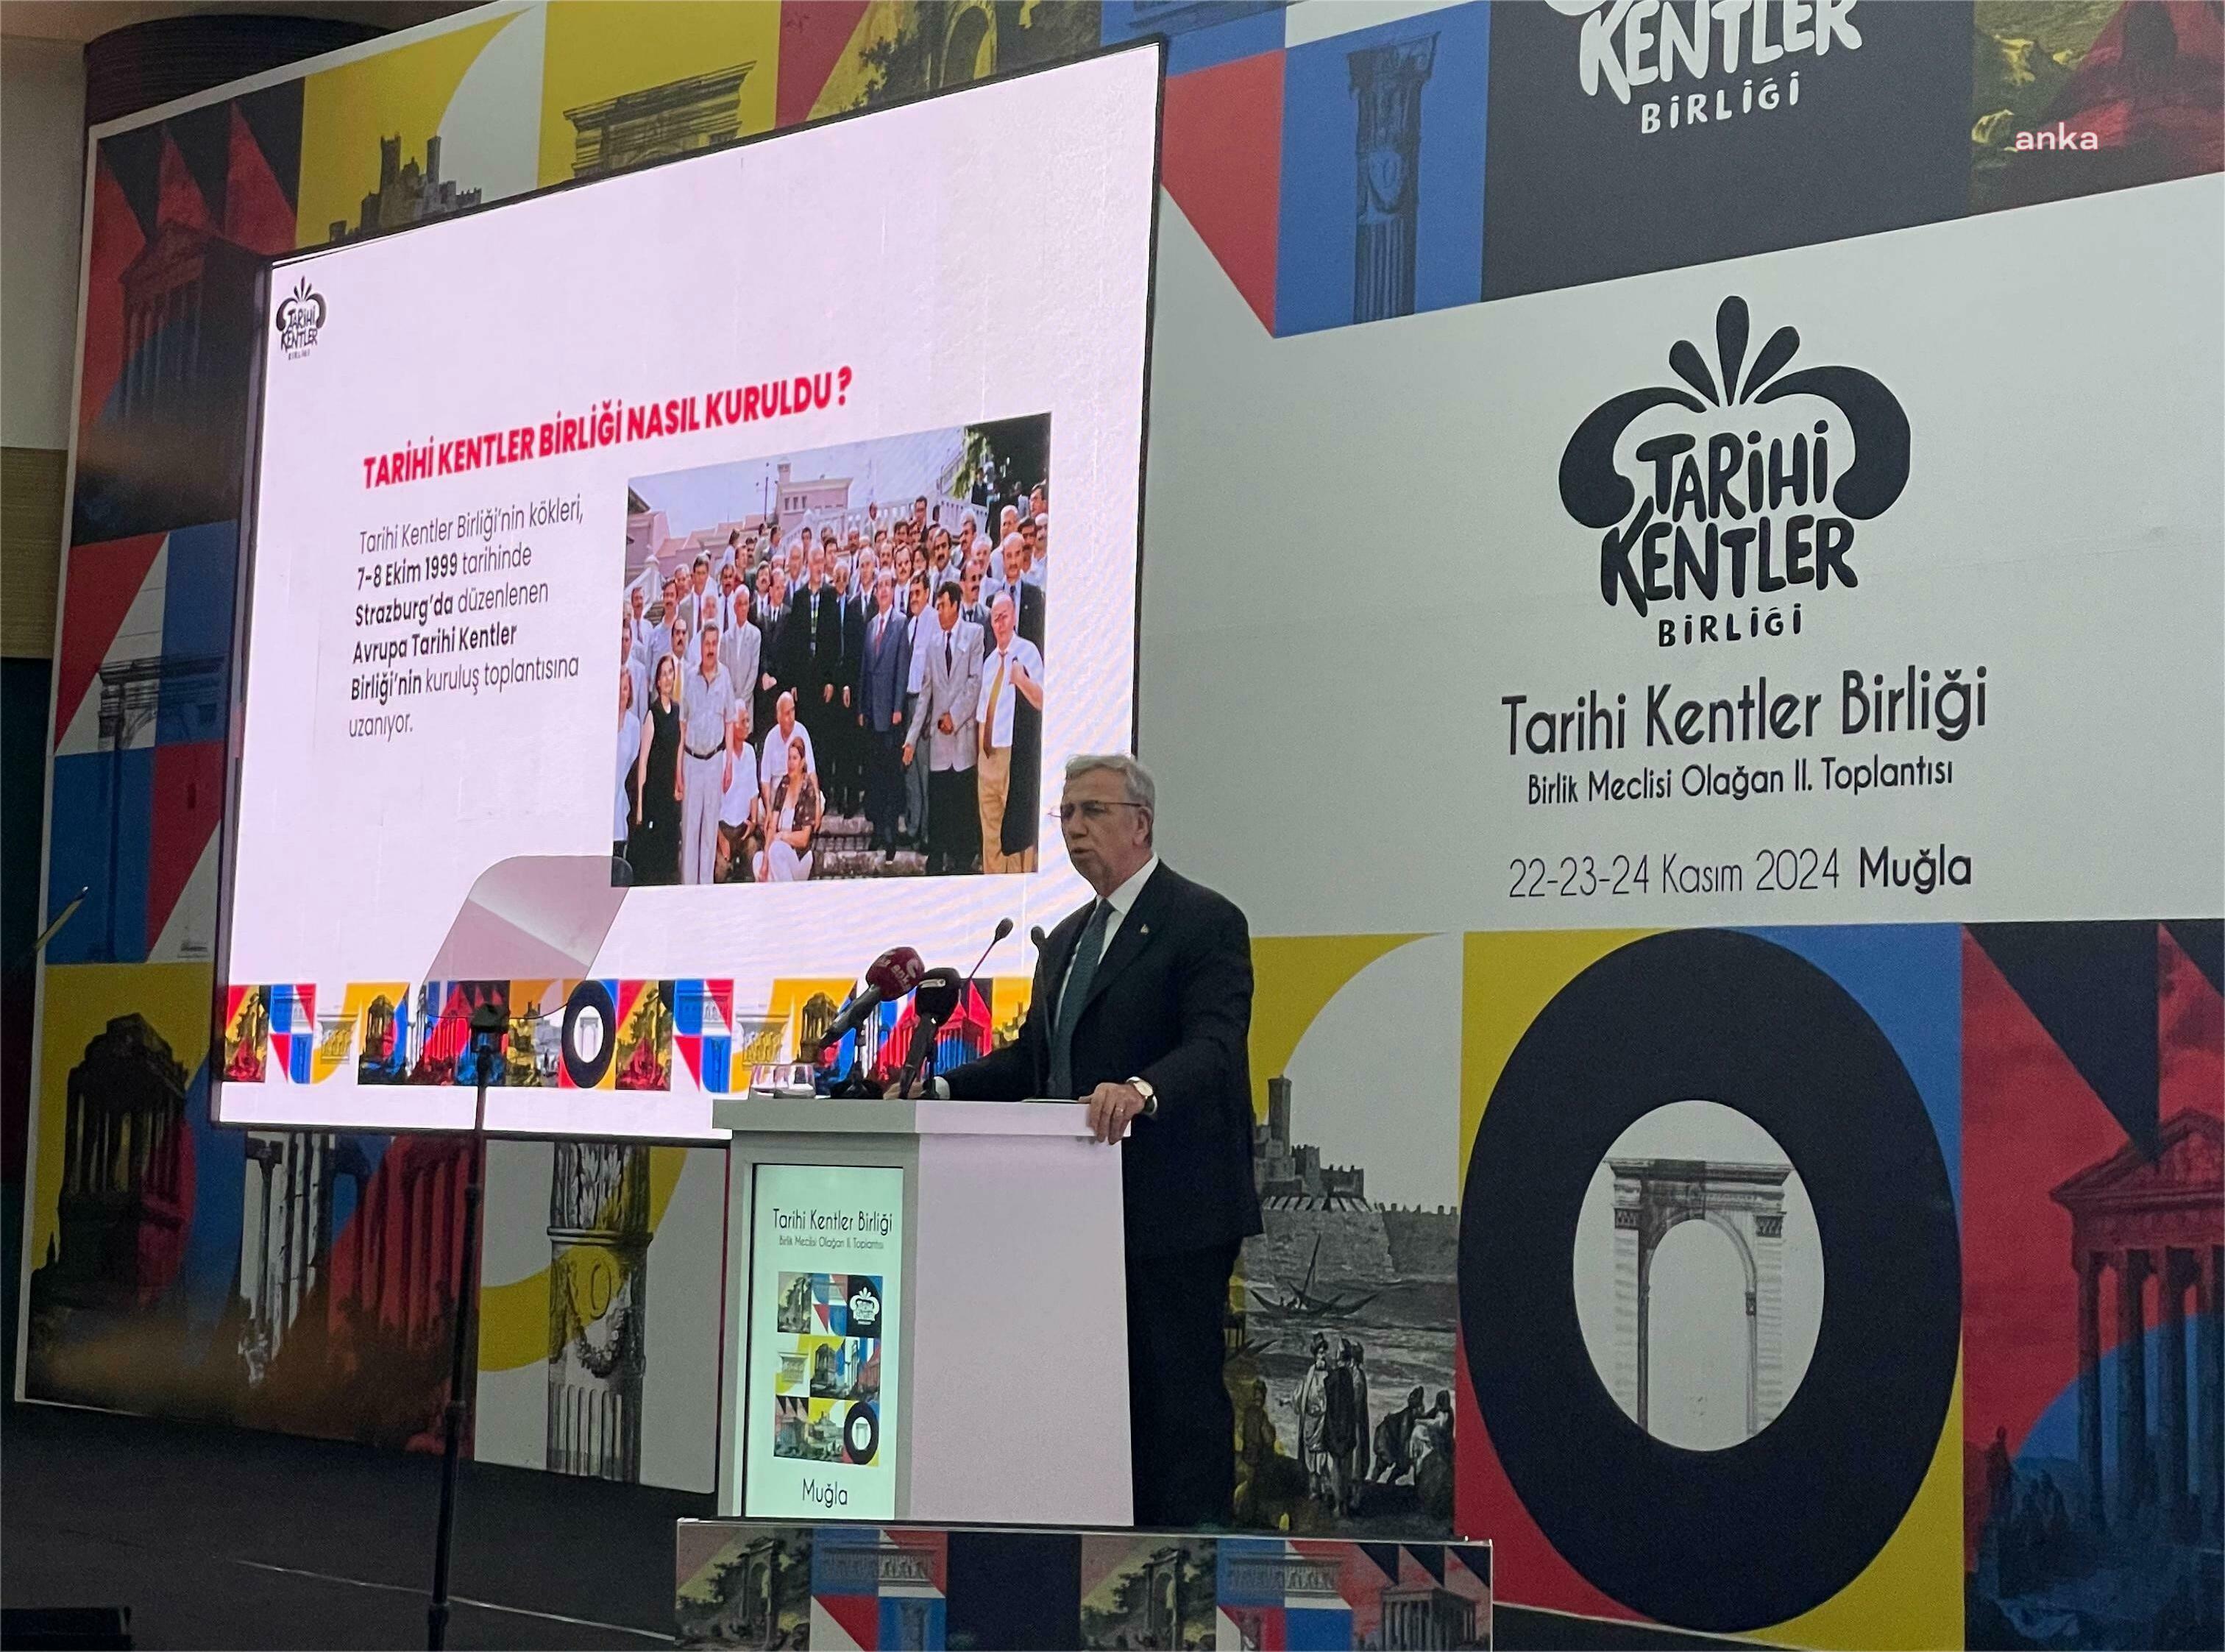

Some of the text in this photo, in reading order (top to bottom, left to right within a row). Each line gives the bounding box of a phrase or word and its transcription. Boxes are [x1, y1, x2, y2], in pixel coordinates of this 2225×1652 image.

[1579, 0, 1863, 104] KENTLER
[280, 325, 318, 352] KENTLER
[363, 435, 434, 489] TARİHİ
[438, 427, 535, 476] KENTLER
[539, 399, 622, 458] BİRLİĞİ
[627, 396, 700, 442] NASIL
[705, 372, 832, 428] KURULDU
[360, 523, 399, 555] Tarihi
[402, 517, 454, 548] Kentler
[528, 493, 583, 528] kökleri,
[357, 542, 532, 591] 7-8 Ekim 1999 tarihinde
[1600, 495, 1859, 618] KENTLER
[355, 581, 549, 627] Strazburg'da düzenlenen
[352, 621, 517, 667] Avrupa Tarihi Kentler
[425, 664, 480, 695] kuruluş
[484, 656, 579, 693] toplantısına
[349, 712, 414, 742] uzanıyor.
[1502, 665, 1987, 755] Tarihi Kentler Birliği
[1528, 754, 1952, 804] Birlik Meclisi Olağan II. Toplantısı
[1509, 843, 1971, 898] 22-23-24 Kasım 2024 Muğla
[773, 1208, 893, 1236] Tarihi Kentler Birliği
[853, 1237, 884, 1249] Toplan
[802, 1478, 848, 1509] Muğla
